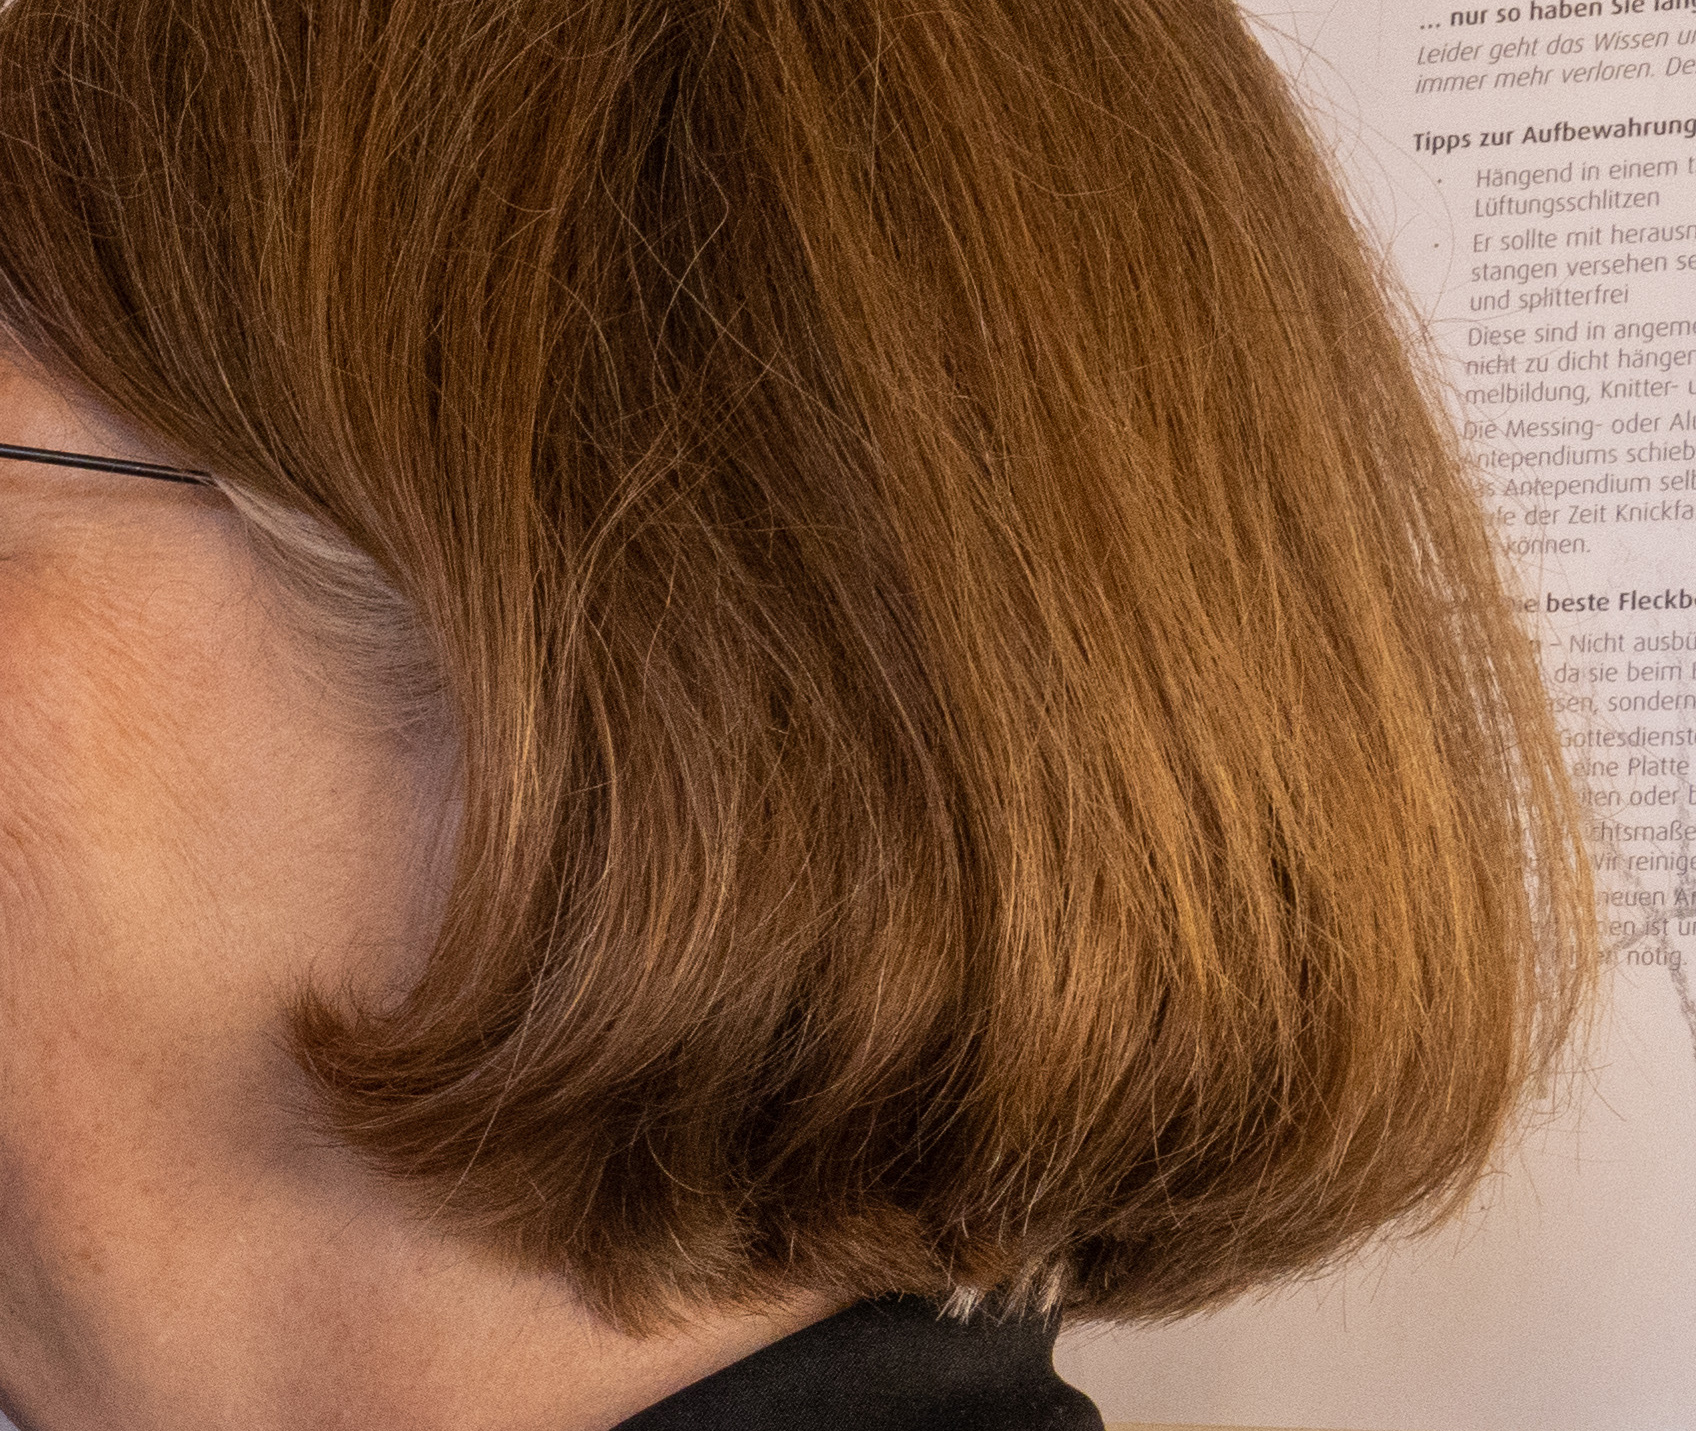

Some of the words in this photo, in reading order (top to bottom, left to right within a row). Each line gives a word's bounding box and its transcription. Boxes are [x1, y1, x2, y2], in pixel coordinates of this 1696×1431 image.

[1450, 9, 1488, 27] nur
[1496, 7, 1521, 24] so
[1529, 0, 1602, 21] haben
[1417, 41, 1485, 65] Leider
[1489, 36, 1538, 65] geht
[1546, 33, 1585, 56] das
[1595, 30, 1669, 52] Wissen
[1415, 74, 1488, 94] immer
[1494, 65, 1554, 88] mehr
[1562, 60, 1654, 83] verloren.
[1413, 131, 1472, 155] Tipps
[1480, 130, 1515, 147] zur
[1522, 117, 1696, 144] Aufbewahrung
[1476, 162, 1573, 190] Hängend
[1581, 162, 1600, 181] in
[1609, 160, 1678, 180] einem
[1475, 189, 1660, 218] Lüftungsschlitzen
[1473, 233, 1492, 253] Er
[1500, 228, 1557, 251] sollte
[1566, 226, 1601, 247] mit
[1472, 263, 1557, 285] stangen
[1567, 253, 1667, 276] versehen
[1470, 289, 1510, 311] und
[1519, 284, 1628, 313] splitterfrei
[1469, 326, 1526, 346] Diese
[1535, 321, 1578, 343] sind
[1587, 321, 1605, 340] in
[1466, 354, 1516, 375] nicht
[1525, 357, 1548, 373] zu
[1557, 350, 1608, 371] dicht
[1466, 381, 1590, 406] melbildung,
[1601, 379, 1679, 399] Knitter-
[1463, 420, 1497, 440] Die
[1506, 417, 1603, 440] Messing-
[1611, 412, 1661, 434] oder
[1627, 440, 1696, 463] schieb
[1504, 473, 1650, 500] Antependium
[1524, 505, 1561, 525] der
[1568, 503, 1606, 524] Zeit
[1616, 500, 1695, 522] Knickfa
[1546, 592, 1610, 613] beste
[1619, 588, 1696, 611] Fleckb
[1569, 632, 1625, 653] Nicht
[1554, 662, 1580, 683] da
[1589, 663, 1618, 683] sie
[1627, 661, 1682, 682] beim
[1559, 726, 1696, 748] Gottesdienst
[1572, 757, 1619, 777] eine
[1628, 755, 1690, 777] Platte
[1630, 786, 1680, 806] oder
[1645, 919, 1669, 936] ist
